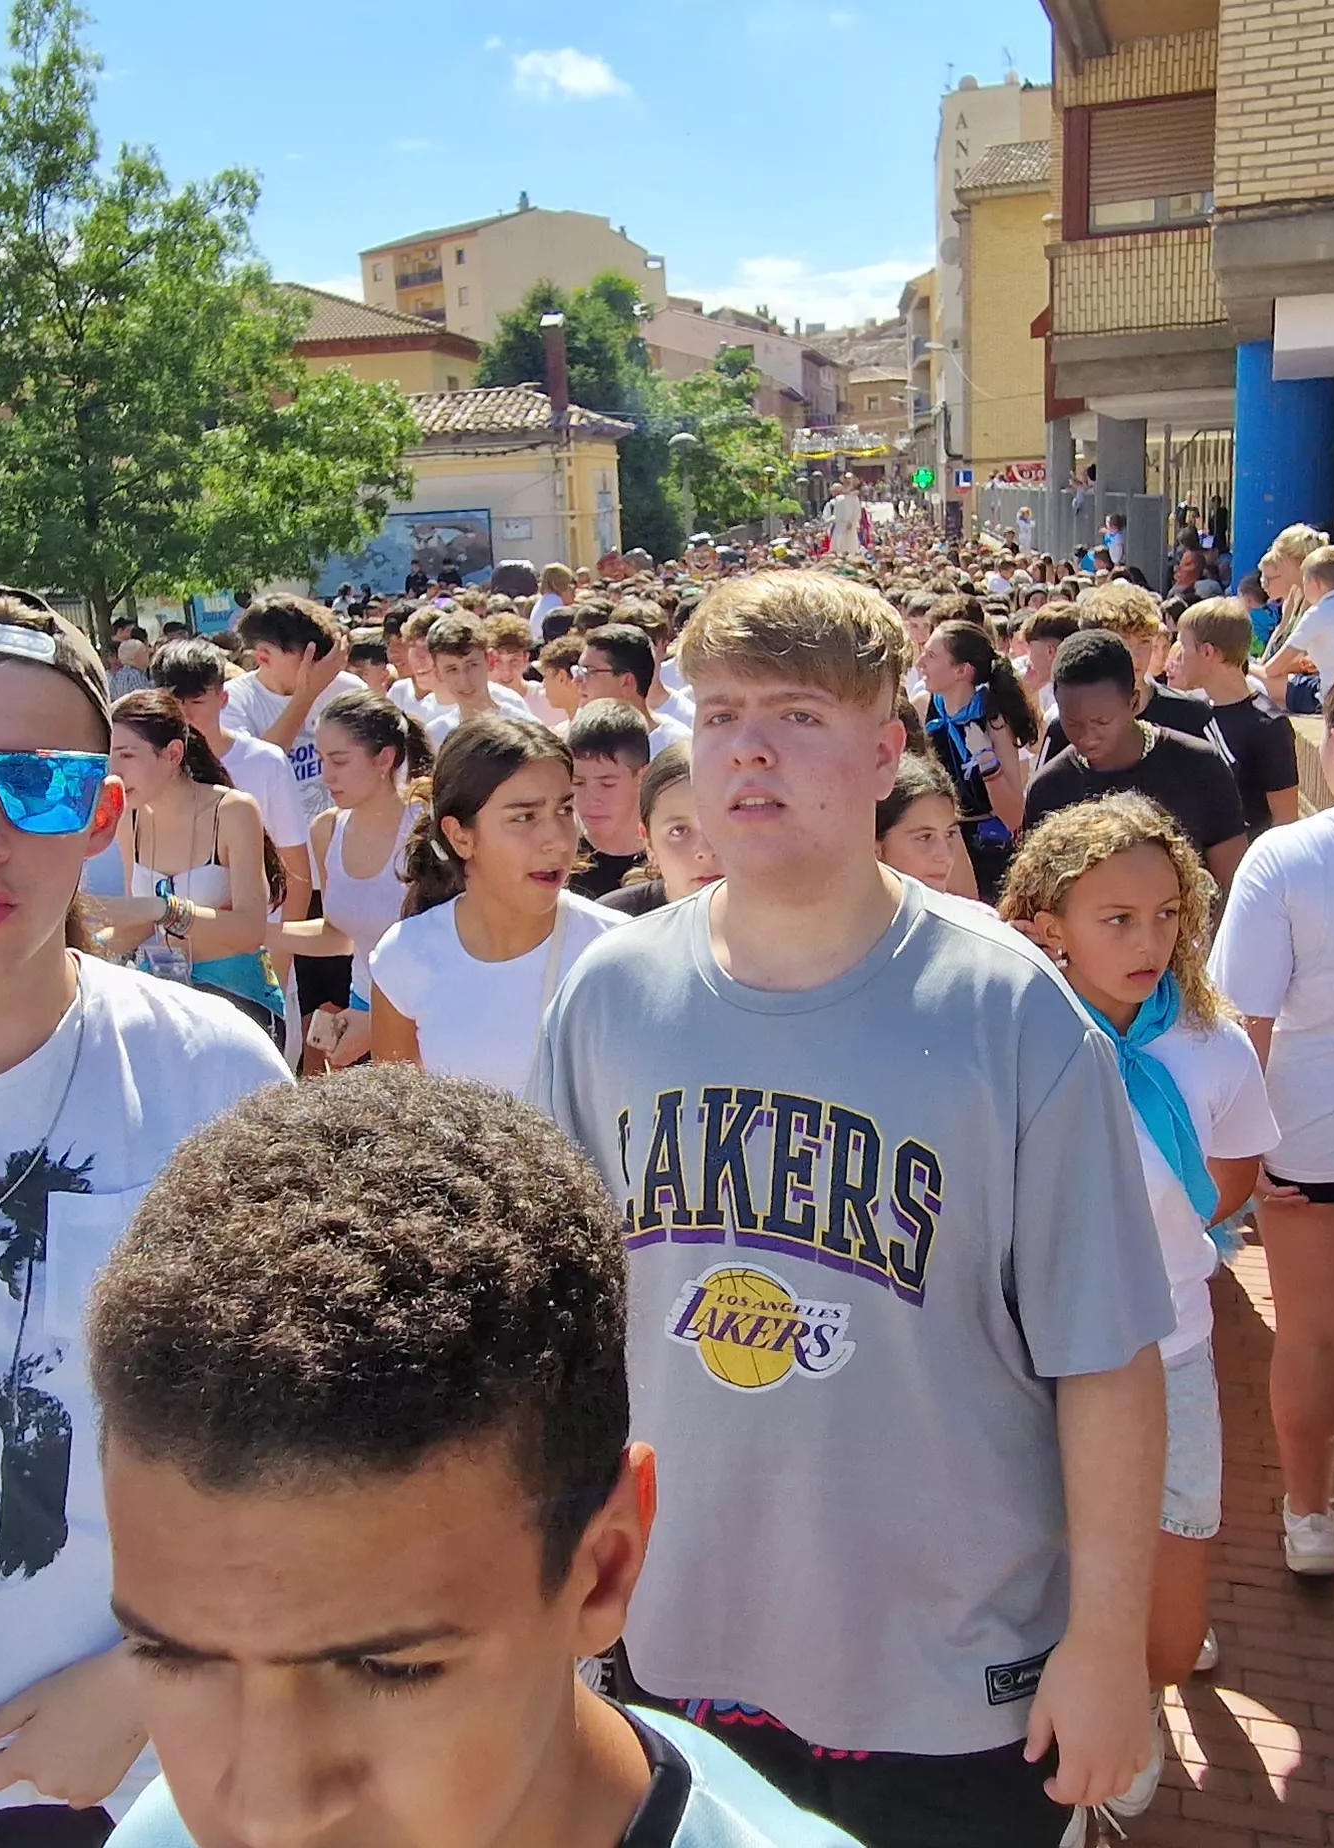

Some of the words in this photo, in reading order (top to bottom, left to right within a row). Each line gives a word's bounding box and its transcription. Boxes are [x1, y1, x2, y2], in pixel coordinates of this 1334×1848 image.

[667, 1285, 846, 1372] LAKERS
[717, 1293, 749, 1307] LOS
[753, 1300, 843, 1320] ANGELES
